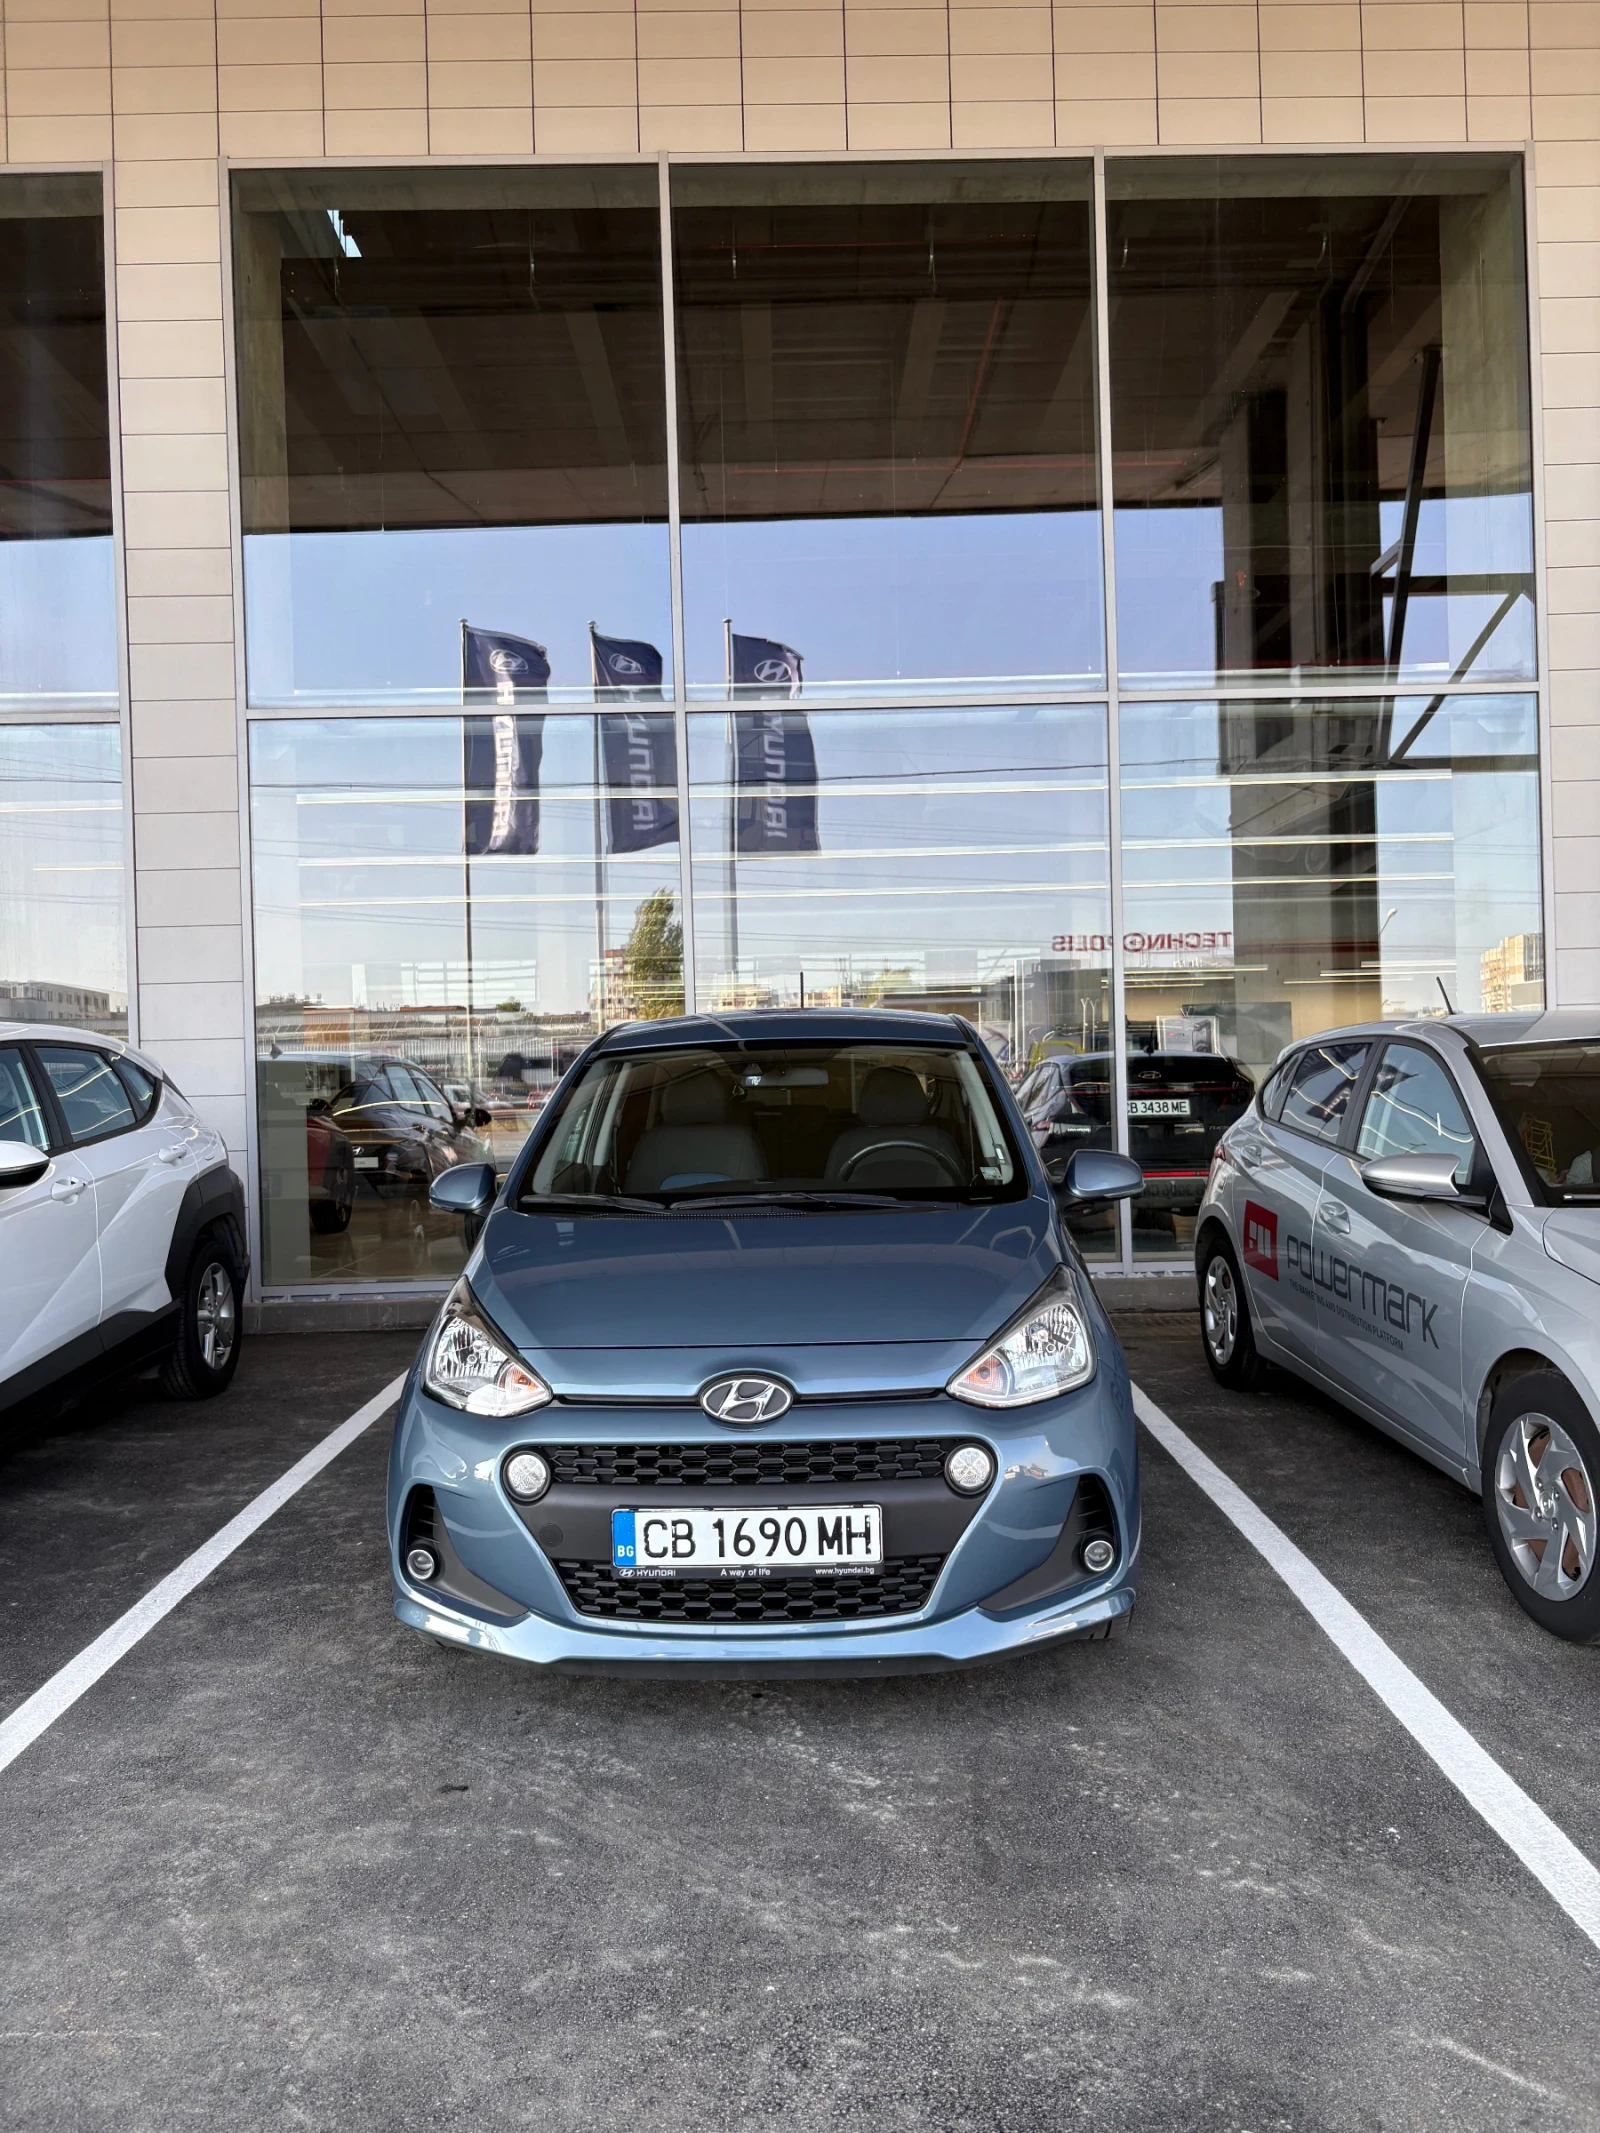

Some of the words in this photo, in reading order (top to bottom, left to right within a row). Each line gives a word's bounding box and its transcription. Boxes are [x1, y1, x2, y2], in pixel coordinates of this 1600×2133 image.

[1140, 1101, 1169, 1113] 3438
[1171, 1101, 1188, 1113] ME
[1286, 1234, 1440, 1350] powermark
[1336, 1304, 1373, 1333] DISTRIBUTION
[1372, 1325, 1404, 1350] PLATFORM
[643, 1518, 696, 1558] CB
[712, 1516, 807, 1558] 1690
[817, 1515, 872, 1556] MH
[617, 1545, 634, 1557] BG
[636, 1569, 676, 1577] HYUNDAI
[720, 1568, 728, 1577] A
[729, 1569, 746, 1578] way
[747, 1568, 757, 1576] of
[758, 1567, 771, 1576] life
[815, 1567, 875, 1577] www.hyundai.bg
